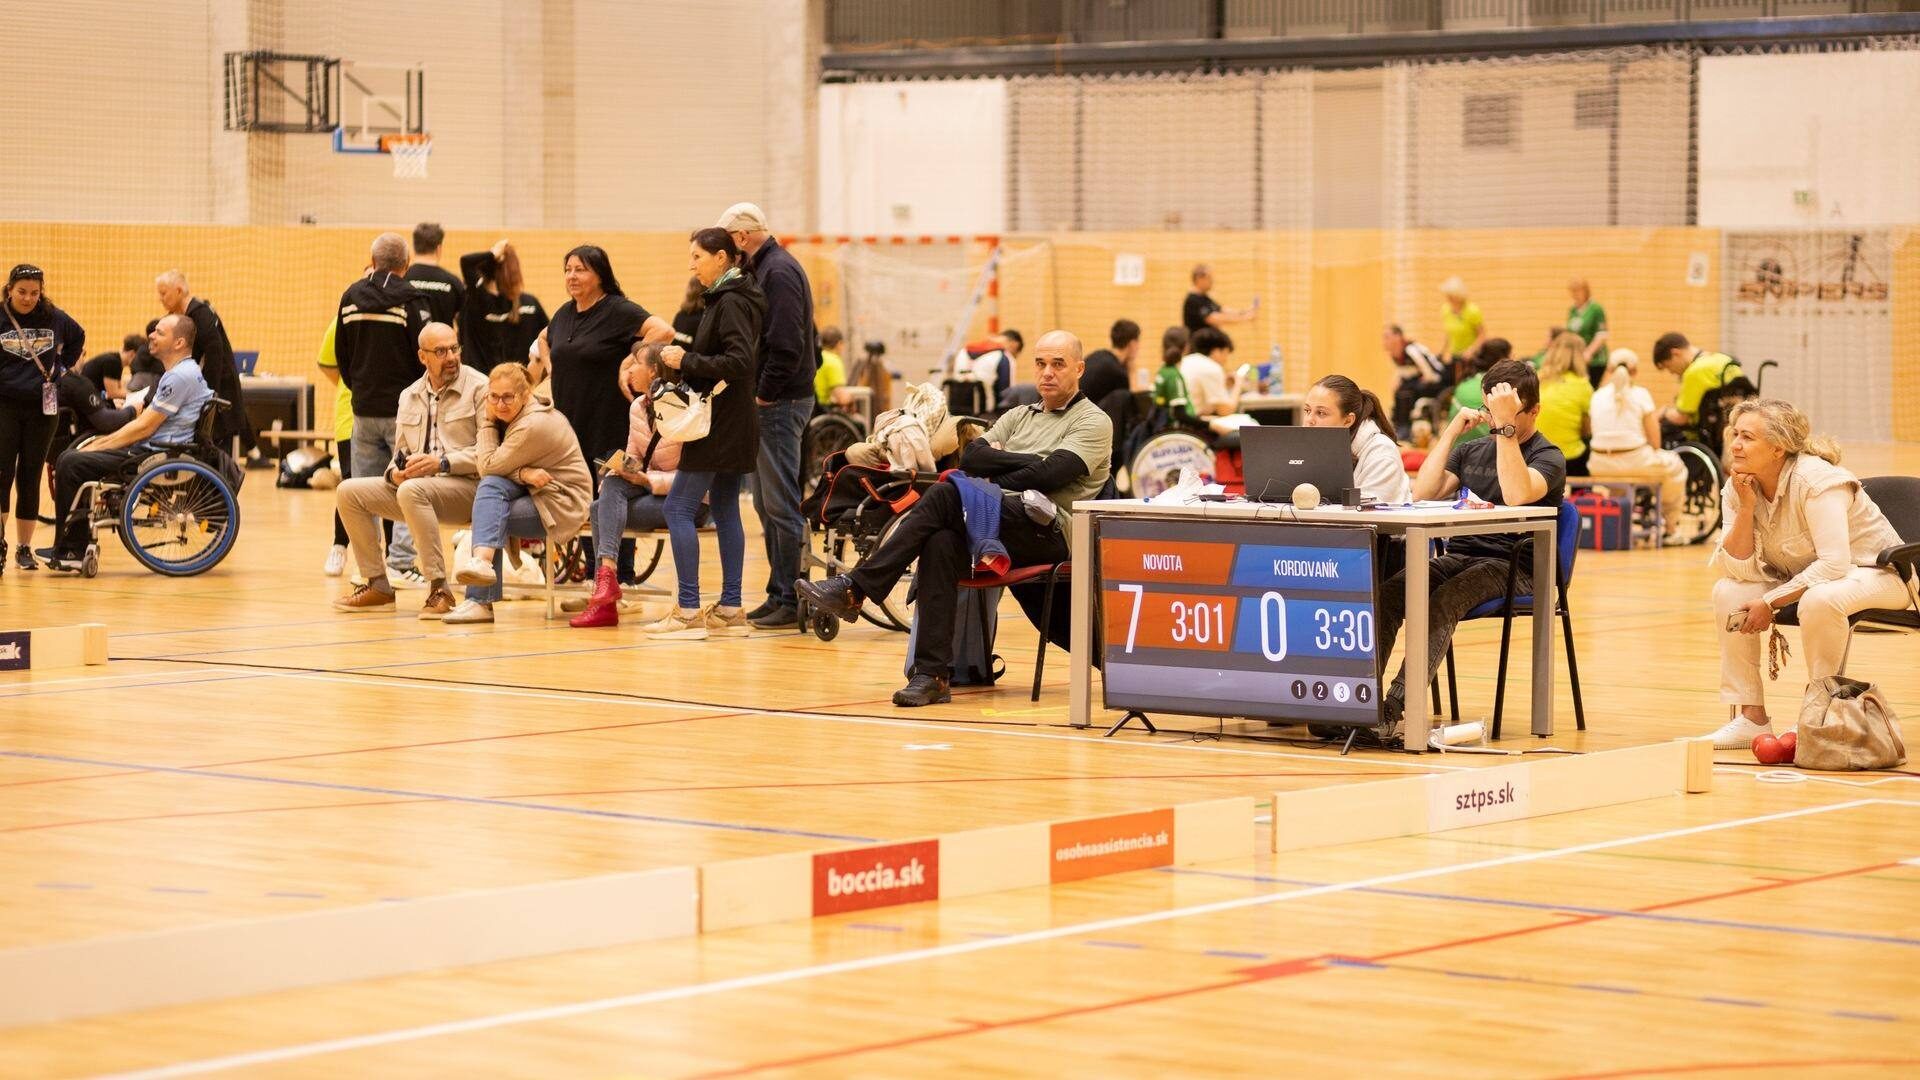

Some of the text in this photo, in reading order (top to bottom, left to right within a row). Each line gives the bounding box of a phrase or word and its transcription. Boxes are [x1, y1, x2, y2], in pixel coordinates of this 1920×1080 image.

[1142, 553, 1183, 572] NOVOTA
[1273, 558, 1339, 578] KORDOVANÍK
[1118, 584, 1143, 653] 7
[1170, 600, 1224, 645] 3:01
[1260, 591, 1288, 662] 0
[1314, 608, 1374, 652] 3:30
[1455, 781, 1515, 813] sztps.sk
[1055, 829, 1170, 862] osobnaasistencia.sk
[827, 857, 925, 897] boccia.sk
